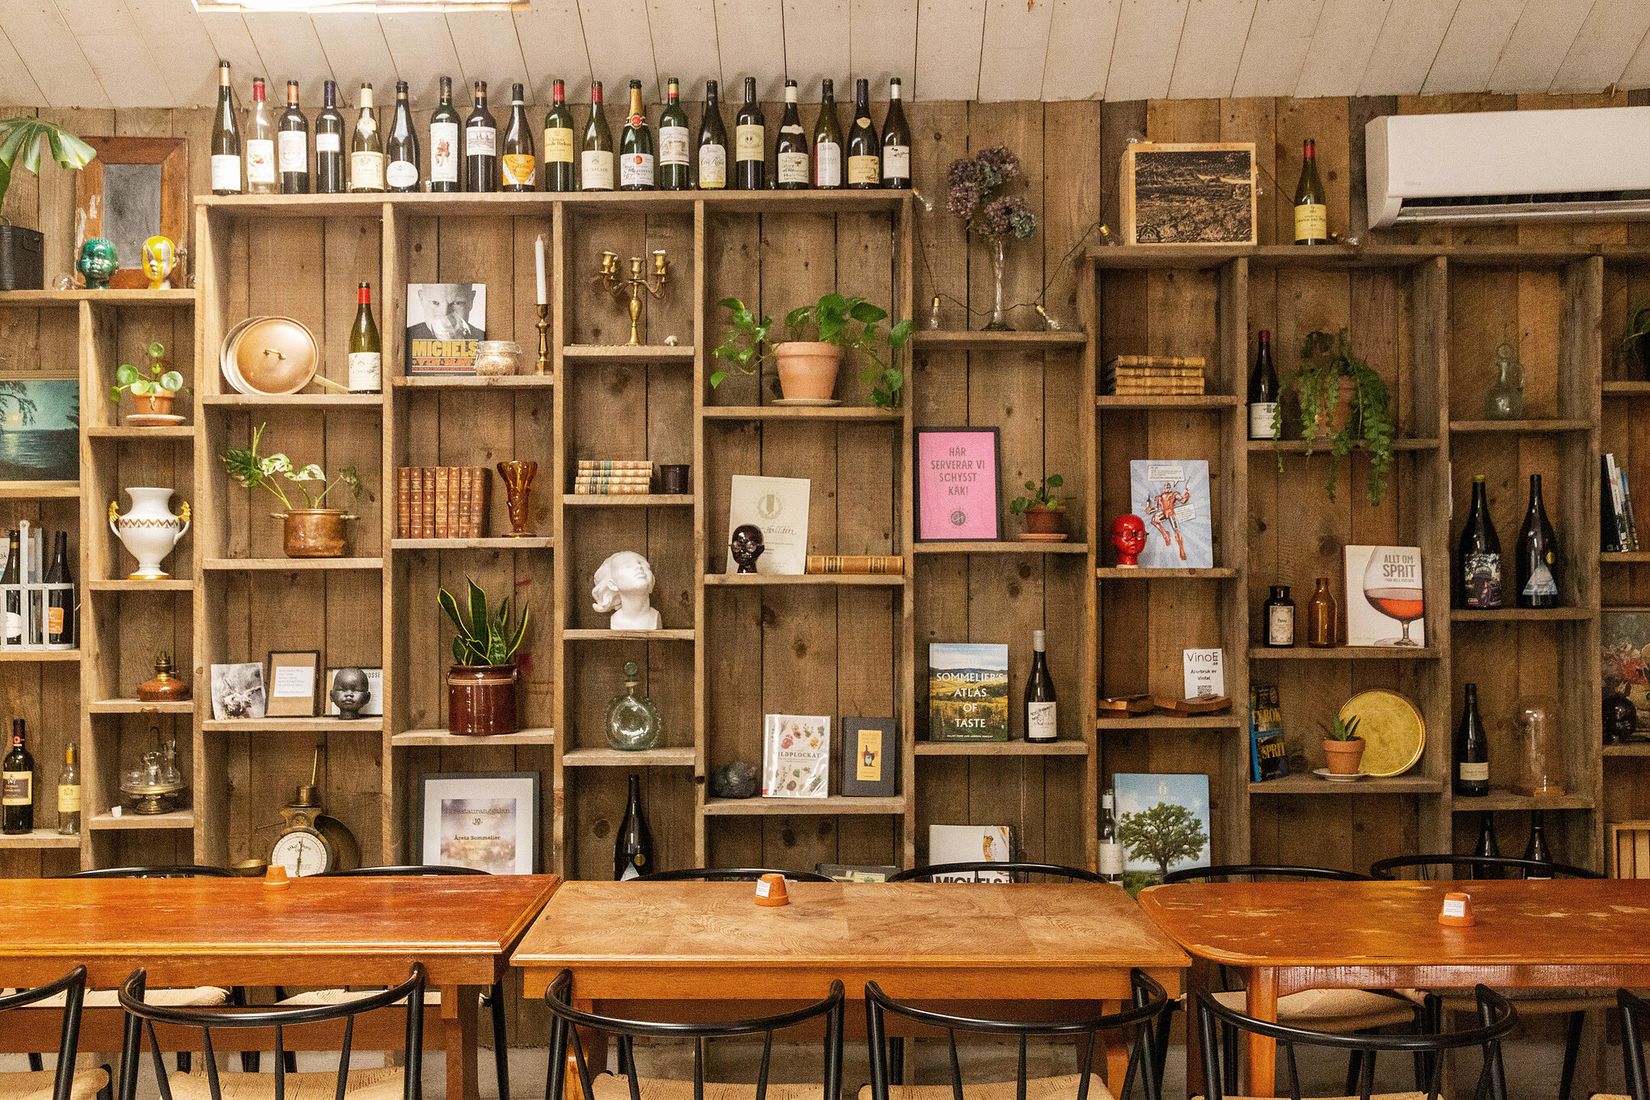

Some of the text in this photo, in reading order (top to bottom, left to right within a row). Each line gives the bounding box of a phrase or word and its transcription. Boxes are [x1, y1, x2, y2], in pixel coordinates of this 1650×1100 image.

[412, 340, 478, 357] MICHELS
[930, 460, 985, 470] SERVERAR VI
[939, 472, 977, 482] SCHYSST
[1384, 554, 1414, 564] ALLT OM
[1383, 564, 1416, 578] SPRIT
[1186, 652, 1219, 662] VinoE
[936, 672, 1004, 682] SOMMELIER'S
[954, 688, 987, 697] ATLAS
[963, 703, 979, 713] OF
[955, 718, 986, 728] TASTE
[1261, 742, 1286, 760] SPRIT
